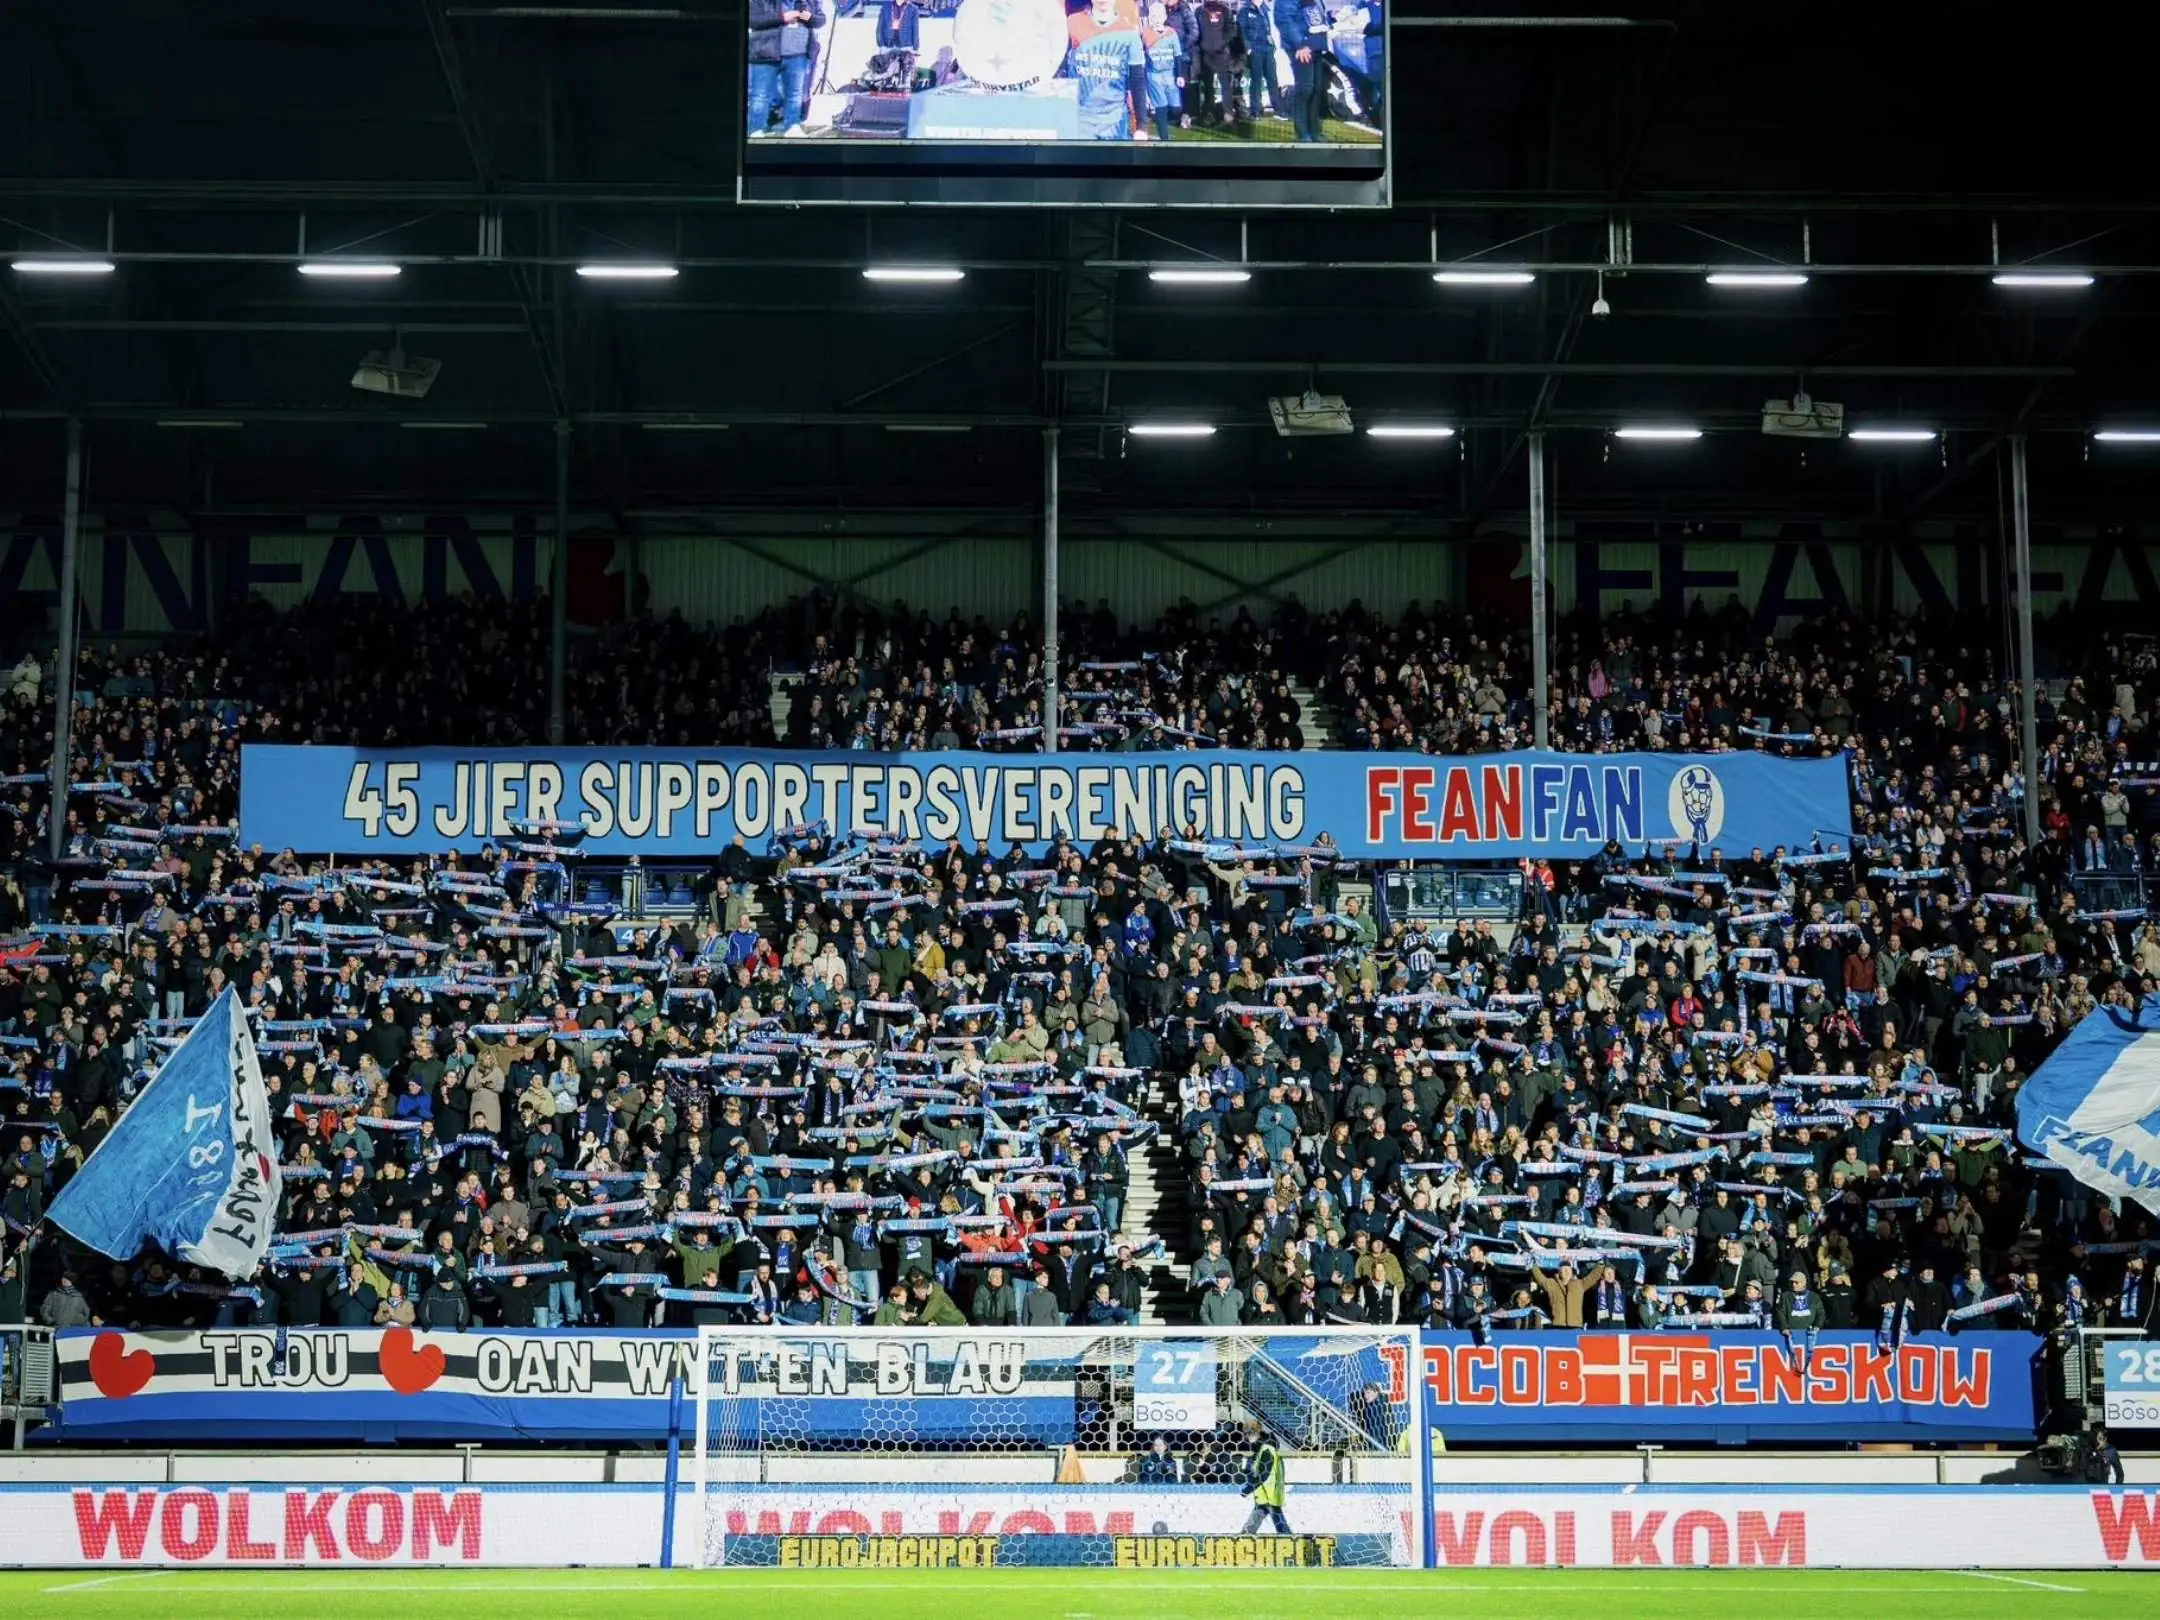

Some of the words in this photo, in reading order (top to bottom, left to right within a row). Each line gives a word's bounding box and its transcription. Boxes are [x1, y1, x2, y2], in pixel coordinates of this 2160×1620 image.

[343, 760, 420, 838] 45
[433, 760, 565, 839] JIER
[579, 760, 1305, 842] SUPPORTERSVERENIGING
[1366, 764, 1645, 843] FEANFAN
[201, 1333, 350, 1388] TROU
[476, 1338, 594, 1394] OAN
[876, 1341, 1026, 1396] BLAU
[1151, 1351, 1200, 1385] 27
[1378, 1344, 1584, 1406] JACOB
[1631, 1342, 1992, 1409] TRENSKOW
[72, 1486, 483, 1560] WOLKOM
[778, 1535, 999, 1568] EUROJACKPOT
